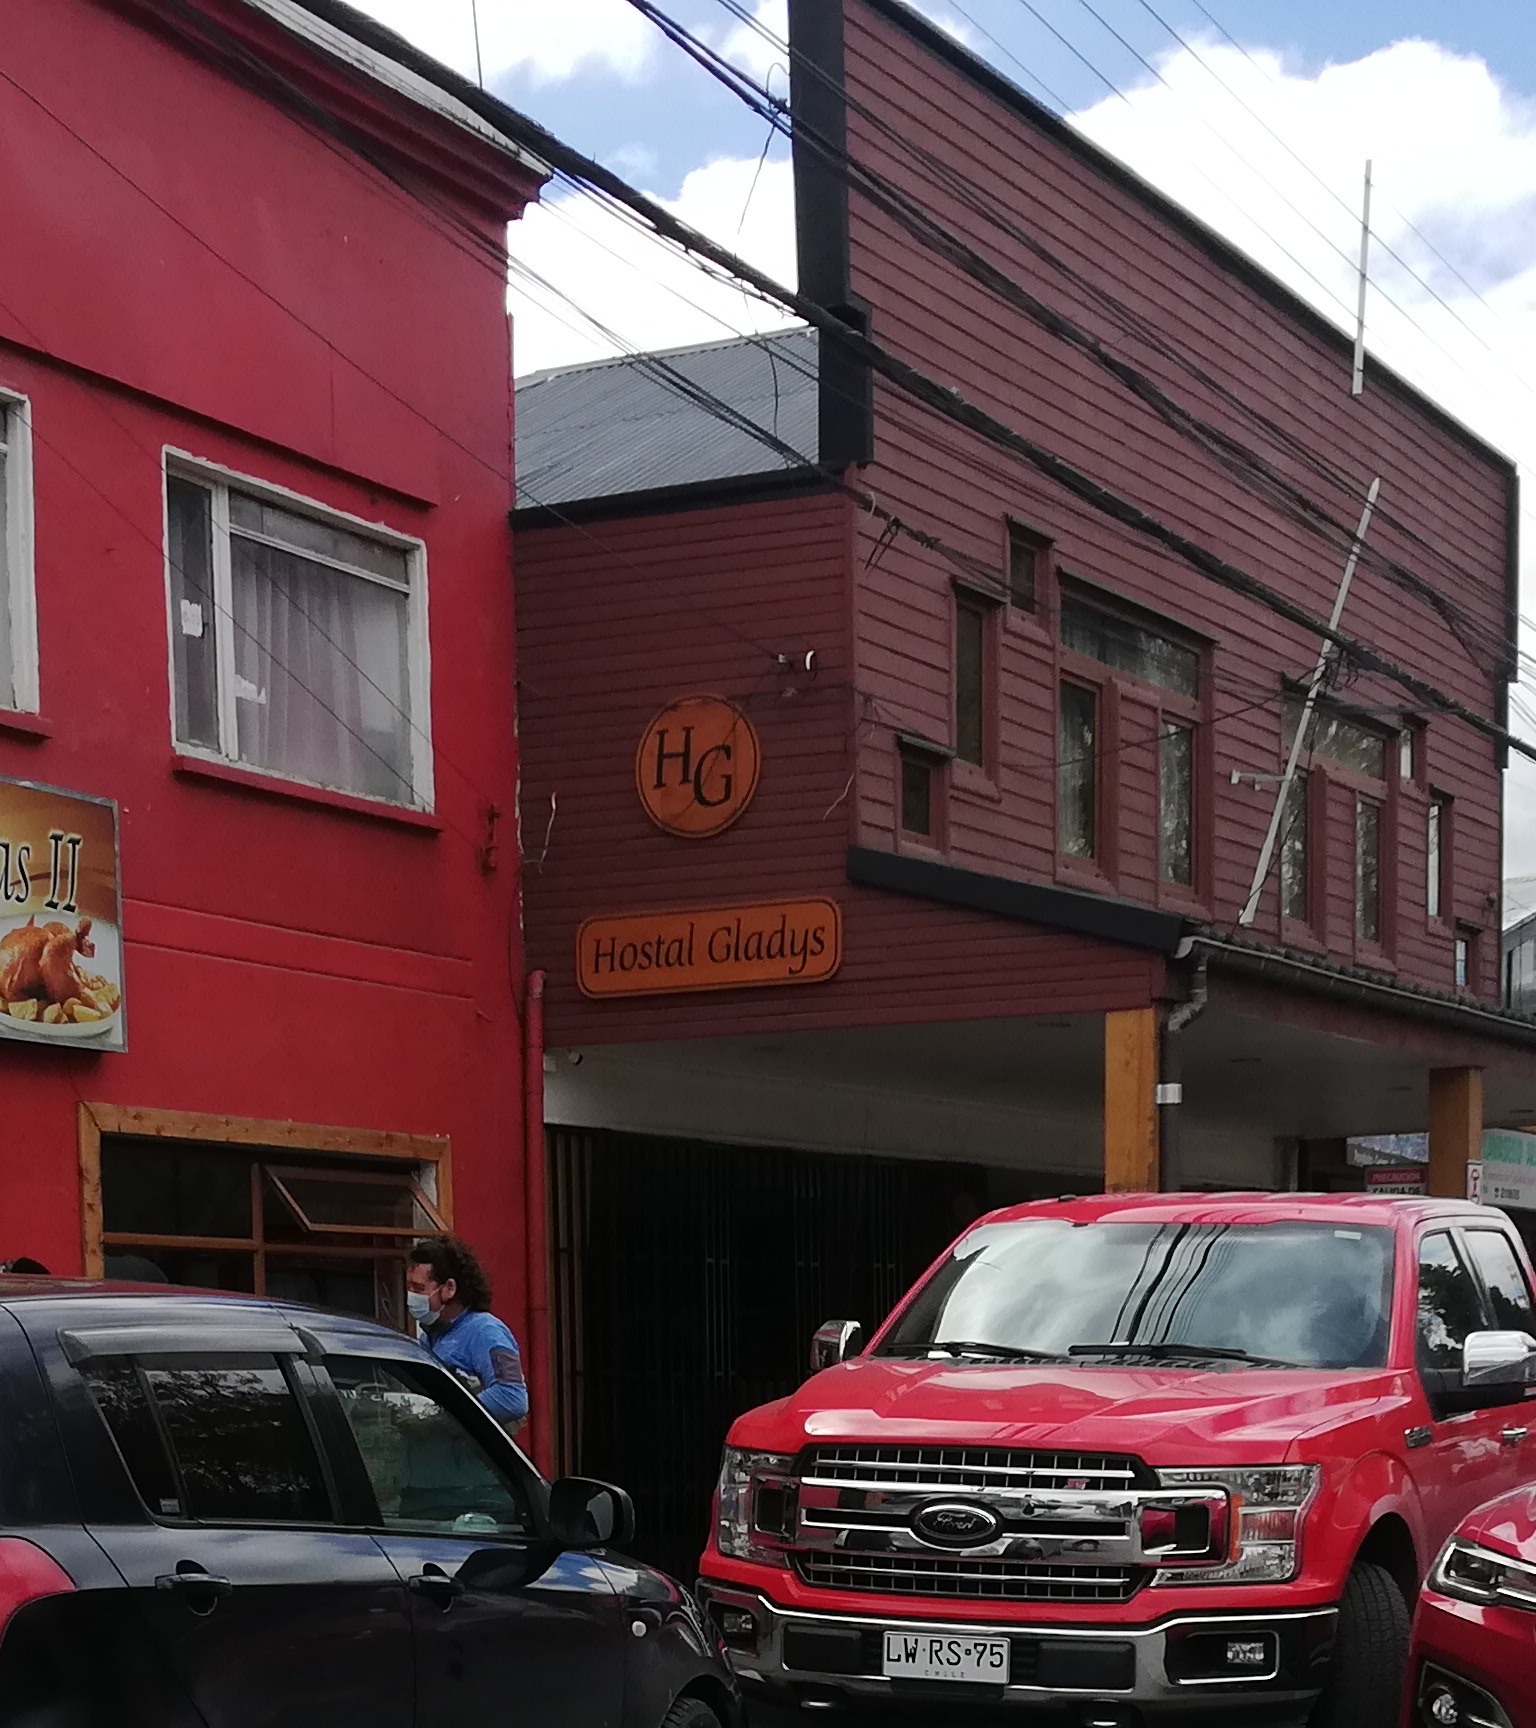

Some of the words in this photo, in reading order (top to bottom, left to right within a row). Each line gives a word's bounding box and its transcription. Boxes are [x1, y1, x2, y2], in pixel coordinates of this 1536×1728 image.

[653, 726, 733, 808] HG
[46, 831, 82, 914] II
[593, 922, 695, 974] Hostal
[708, 914, 826, 976] Gladys
